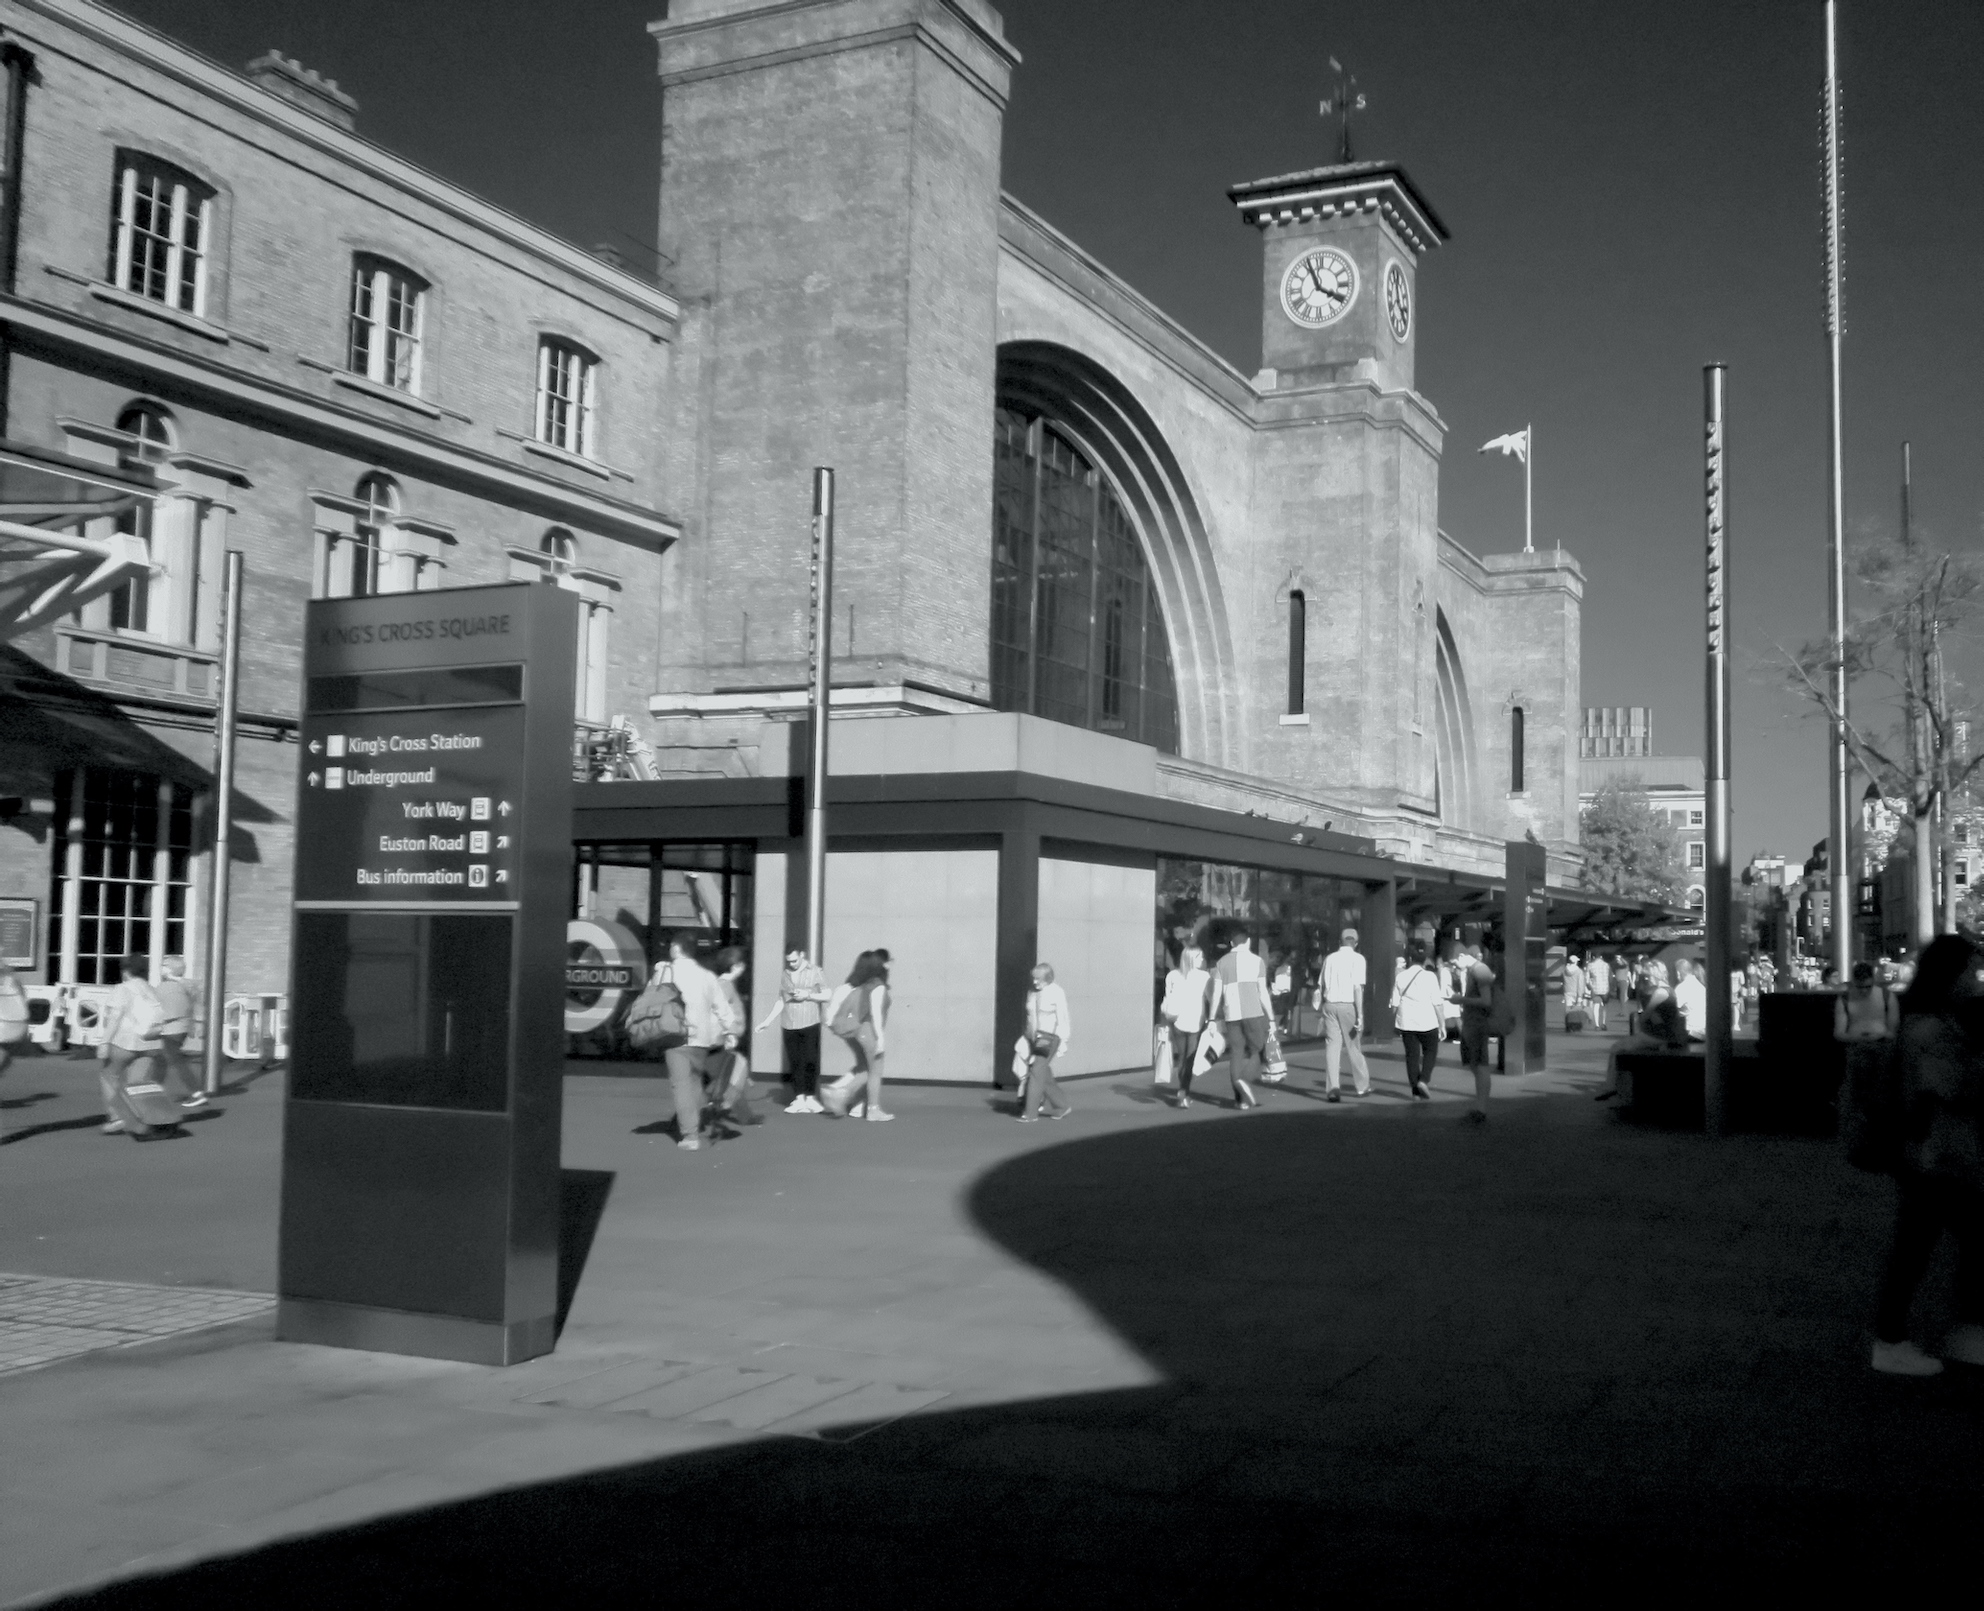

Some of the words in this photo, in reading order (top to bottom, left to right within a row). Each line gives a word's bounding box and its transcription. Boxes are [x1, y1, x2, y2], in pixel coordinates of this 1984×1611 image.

[378, 620, 434, 642] CROSS
[439, 614, 510, 640] SQUARE
[348, 736, 388, 756] King's
[389, 735, 428, 752] Cross
[430, 732, 482, 750] Station
[347, 767, 436, 788] Underground
[402, 801, 434, 819] York
[435, 801, 467, 821] Way
[380, 835, 427, 852] Euston
[429, 834, 466, 851] Road
[357, 868, 382, 884] Bus
[383, 868, 464, 884] information
